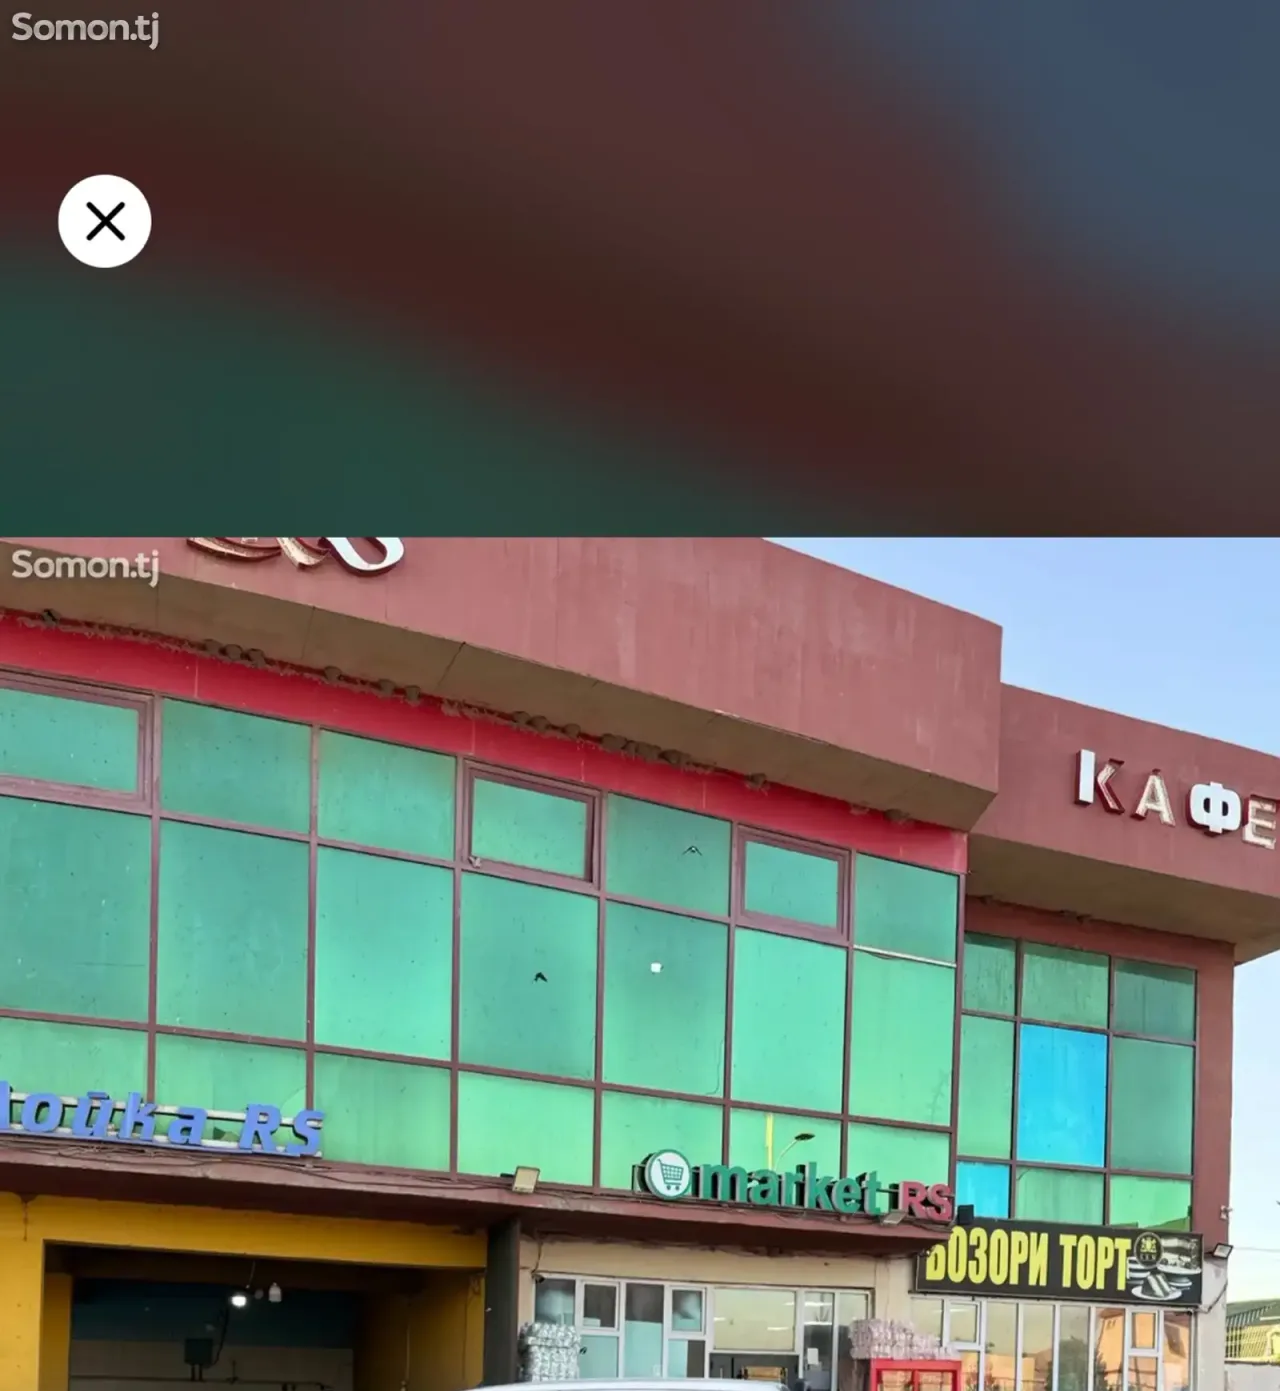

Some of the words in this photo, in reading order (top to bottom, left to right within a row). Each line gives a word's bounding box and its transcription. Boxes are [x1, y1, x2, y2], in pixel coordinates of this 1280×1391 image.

[1075, 749, 1280, 850] КАФЕ
[239, 1104, 325, 1156] RS
[700, 1161, 882, 1216] market
[900, 1180, 954, 1222] RS
[1059, 1233, 1131, 1291] ТОРТ
